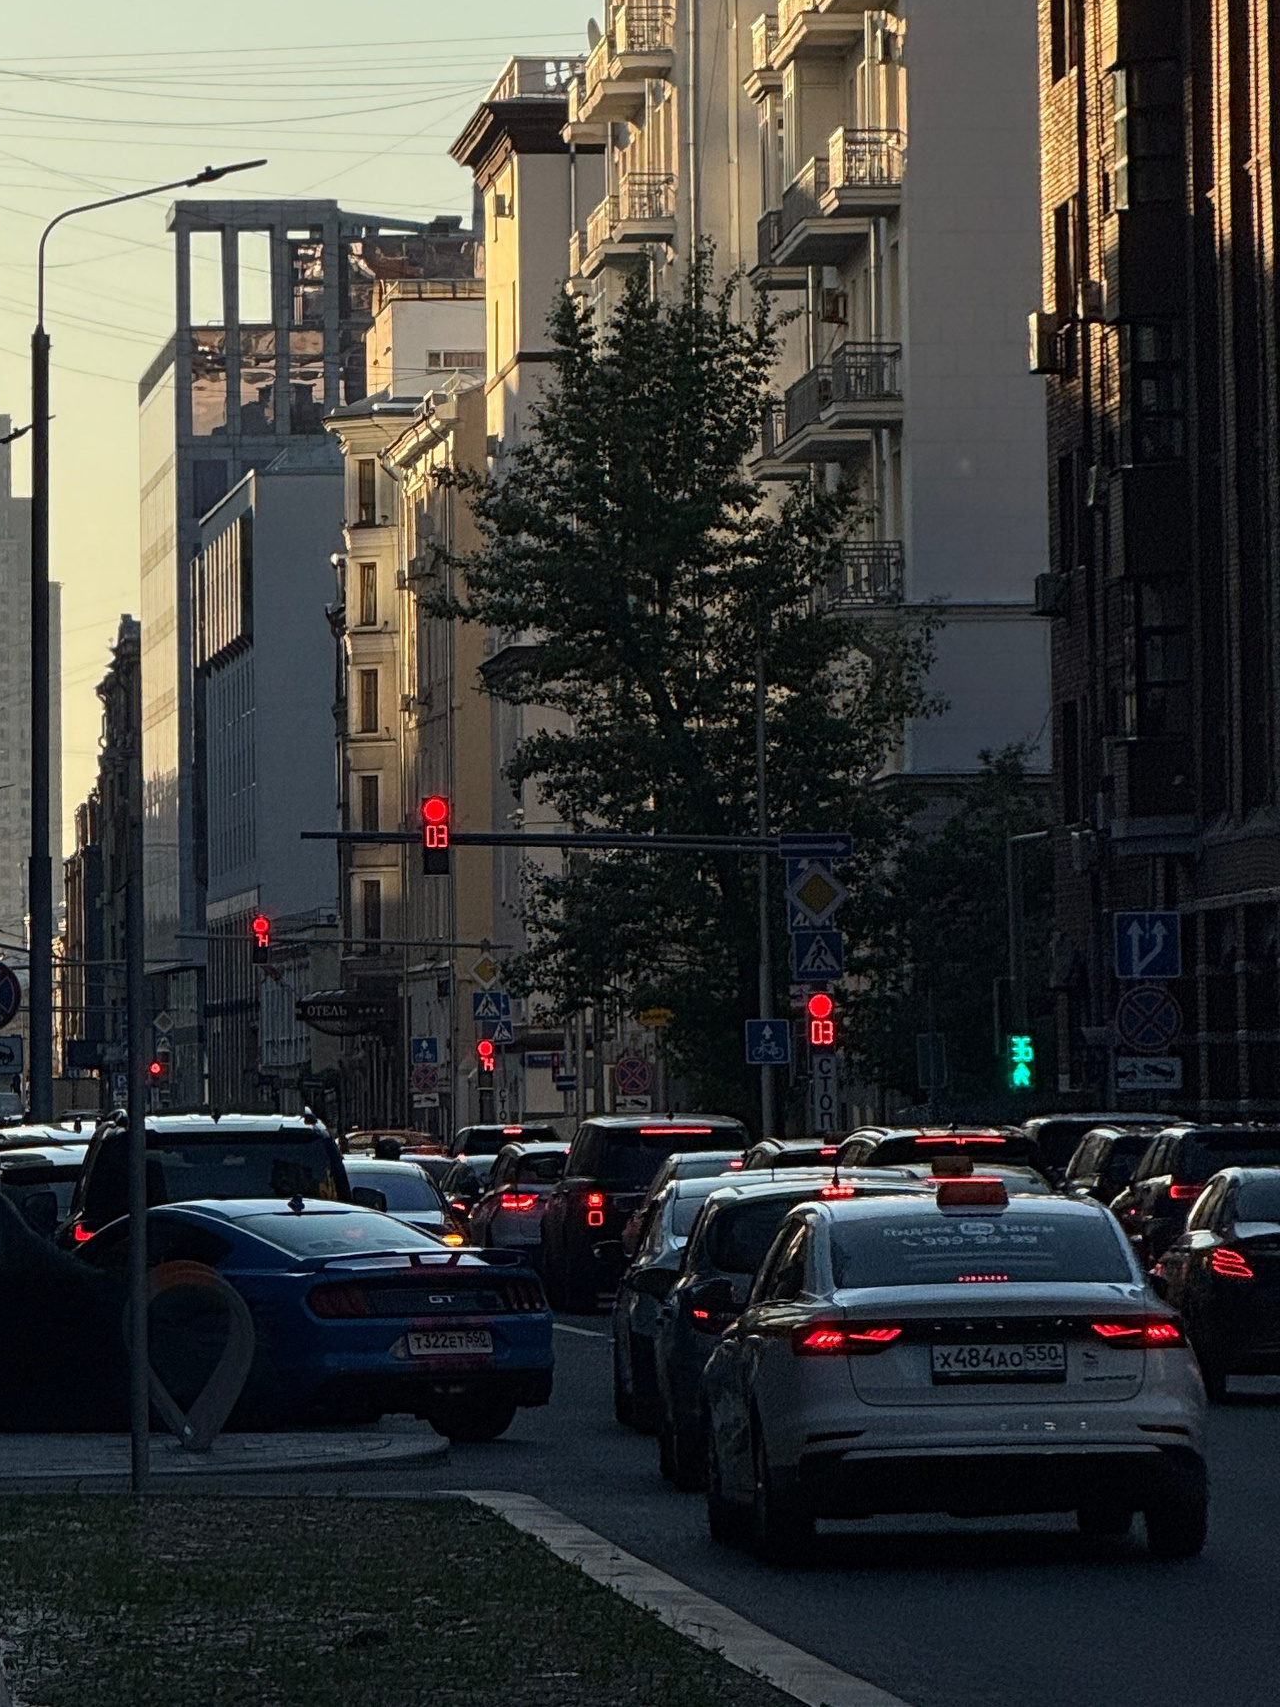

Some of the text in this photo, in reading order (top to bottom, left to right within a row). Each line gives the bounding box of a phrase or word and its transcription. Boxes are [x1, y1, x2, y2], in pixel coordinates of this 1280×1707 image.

[426, 825, 448, 848] 03
[307, 1004, 348, 1016] ОТЕЛЬ
[811, 1020, 834, 1044] 03
[819, 1058, 833, 1129] СТОП
[499, 1089, 507, 1124] СТО
[428, 1294, 455, 1304] GT
[1025, 1345, 1060, 1361] 550
